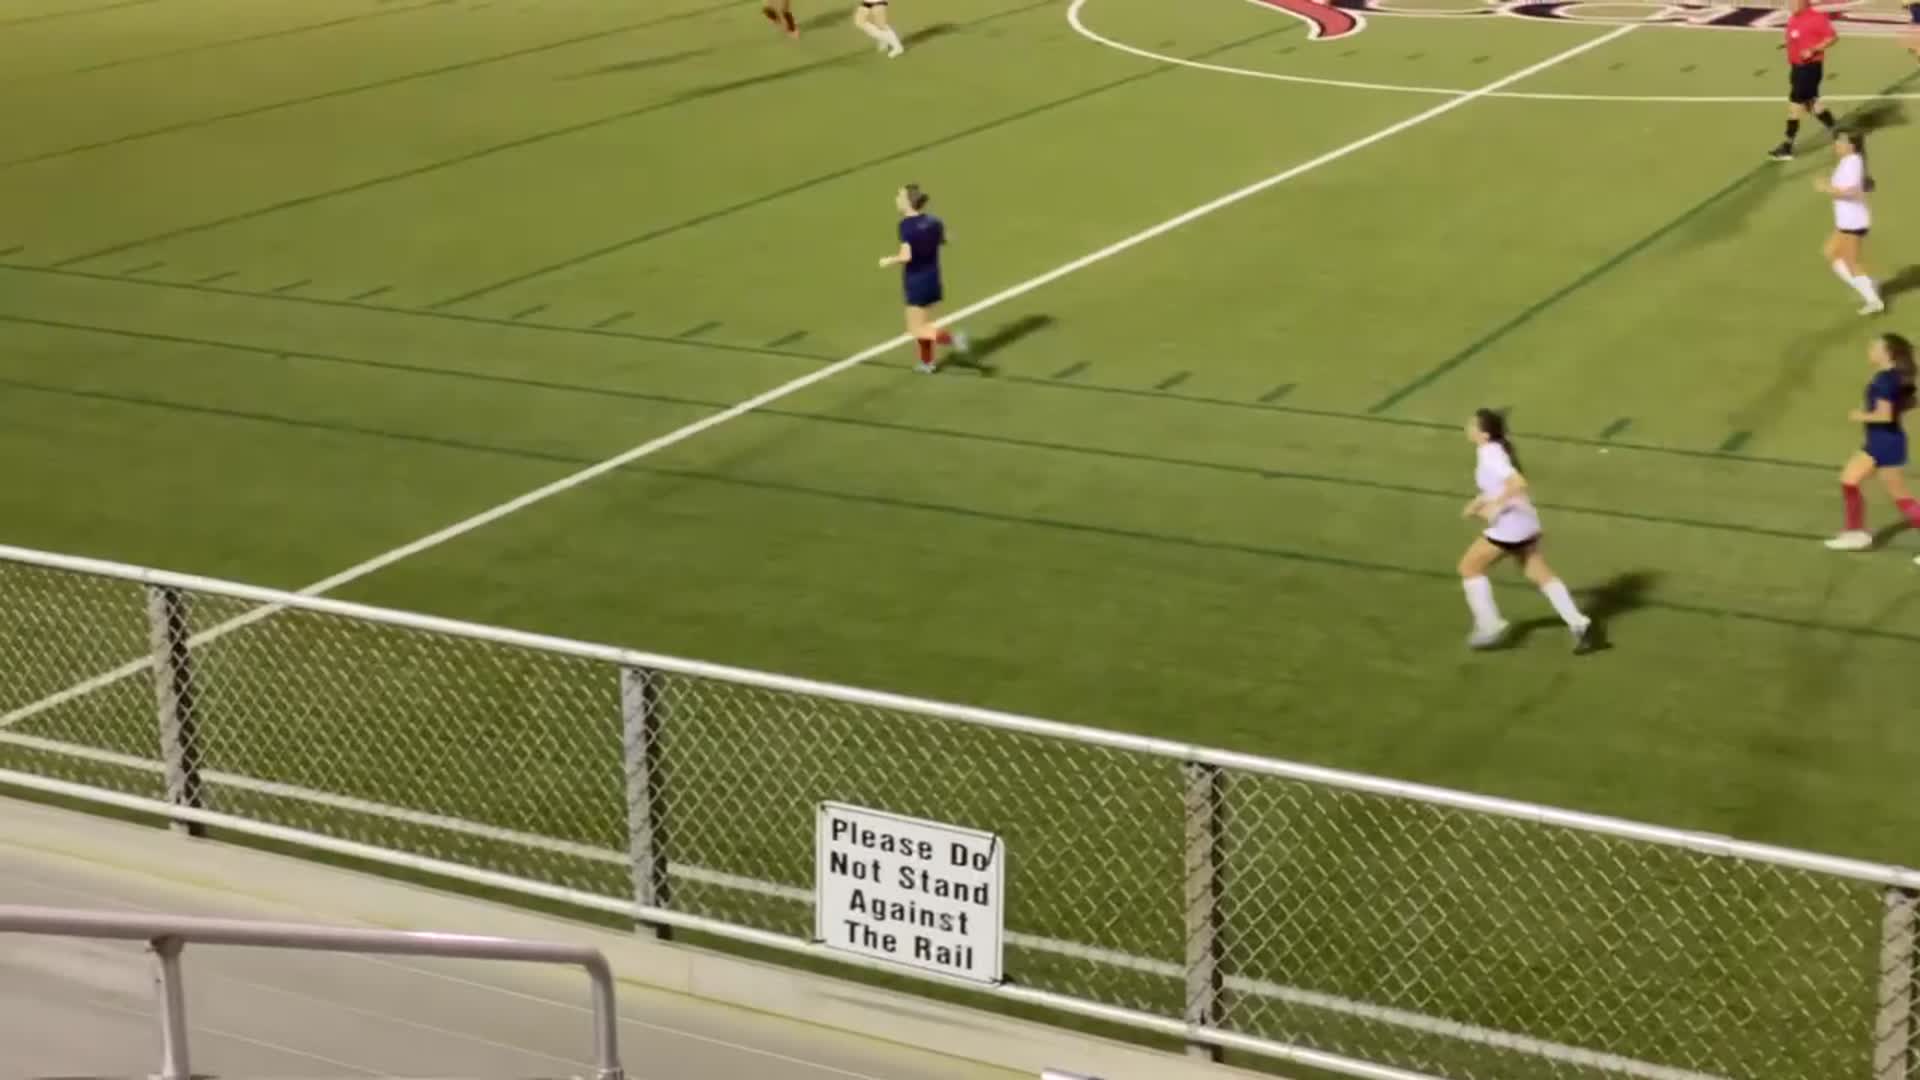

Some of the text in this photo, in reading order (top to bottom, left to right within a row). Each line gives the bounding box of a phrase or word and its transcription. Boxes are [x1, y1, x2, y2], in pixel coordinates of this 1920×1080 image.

[832, 818, 987, 871] Please Do
[830, 851, 989, 906] Not Stand
[849, 889, 968, 935] Against
[844, 920, 973, 970] The Rail
